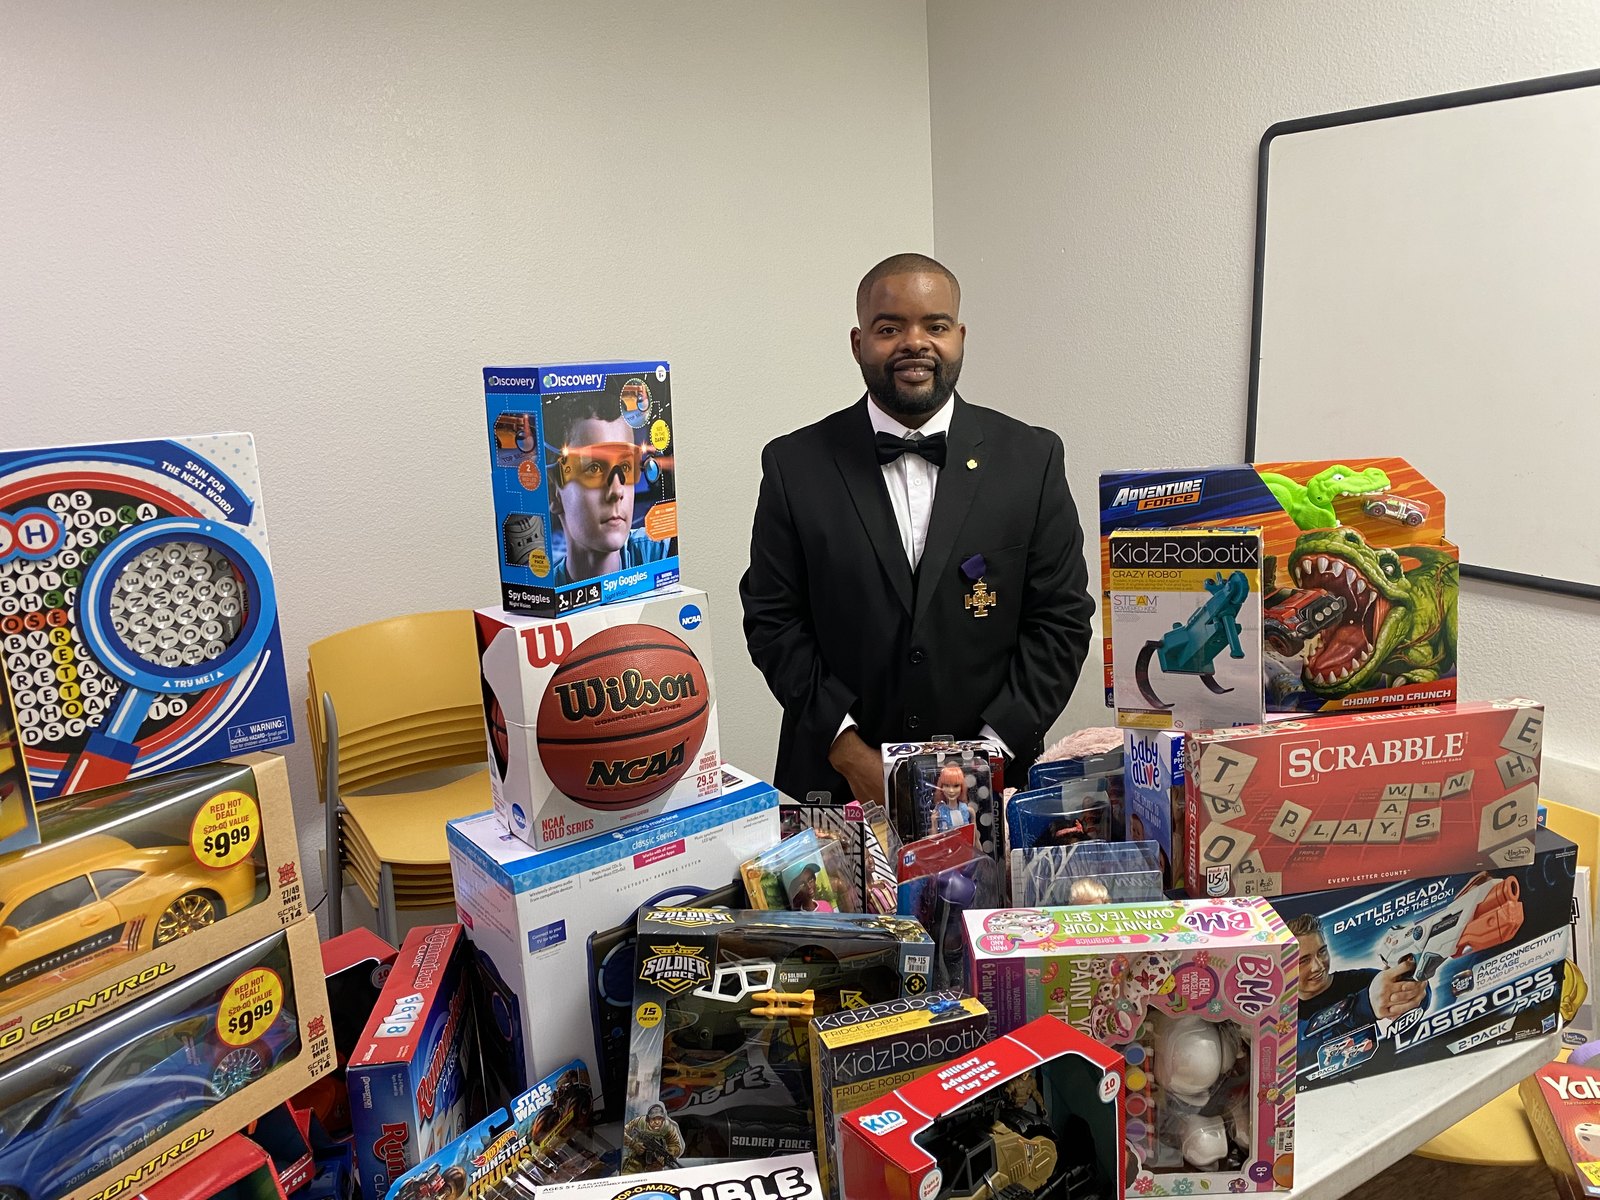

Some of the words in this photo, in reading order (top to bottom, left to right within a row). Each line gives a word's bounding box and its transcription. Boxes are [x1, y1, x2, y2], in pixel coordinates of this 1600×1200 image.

[491, 375, 536, 390] Discovery
[548, 373, 603, 389] Discovery
[185, 461, 209, 479] SPIN
[207, 476, 226, 493] FOR
[161, 461, 181, 476] THE
[180, 471, 206, 490] NEXT
[205, 487, 235, 514] WORD!
[1112, 478, 1203, 507] ADVENTURE
[1143, 494, 1194, 509] FORCE
[1112, 541, 1258, 564] KidzRobotix
[604, 580, 618, 591] Spy
[618, 571, 648, 588] Goggles
[1113, 570, 1145, 578] CRAZY
[1148, 570, 1183, 578] ROBOT
[508, 589, 521, 601] Spy
[522, 592, 550, 605] Goggles
[1113, 594, 1158, 606] STEAM
[681, 614, 701, 625] NCAA
[521, 622, 573, 668] W
[174, 680, 193, 688] TRY
[196, 674, 214, 685] ME!
[554, 668, 698, 722] Wilson
[1342, 697, 1379, 707] CHOMP
[1381, 694, 1404, 703] AND
[1407, 689, 1451, 701] CRUNCH
[594, 710, 647, 727] COMPOSITE
[649, 703, 681, 714] LEATHER
[250, 720, 284, 733] WARNING:
[1131, 734, 1158, 766] baby
[1288, 732, 1465, 778] SCRABBLE
[586, 741, 687, 787] NCAA
[699, 761, 717, 772] OUTDOOR
[697, 771, 718, 788] 29.5"
[1132, 760, 1159, 788] alive
[210, 802, 225, 814] RED
[227, 798, 242, 809] HOT
[215, 808, 237, 820] DEAL!
[846, 809, 861, 818] 126
[228, 815, 249, 827] VALUE
[541, 817, 564, 831] NCAA
[543, 828, 564, 842] GOLD
[567, 819, 594, 835] SERIES
[632, 835, 656, 850] classic
[656, 829, 678, 842] series
[1188, 801, 1198, 887] SCRABBLE
[903, 855, 915, 865] DC
[1208, 872, 1229, 886] USA
[1352, 873, 1378, 881] LETTER
[1380, 869, 1407, 878] COUNTS
[282, 885, 299, 900] 27/49
[1245, 885, 1255, 894] 8+
[277, 902, 302, 917] SCALE
[1098, 909, 1131, 921] TEA
[1133, 908, 1175, 919] OWN
[1333, 901, 1392, 935] BATTLE
[1395, 878, 1449, 908] READY
[1375, 914, 1395, 927] OUT
[1396, 907, 1411, 917] OF
[1411, 898, 1429, 911] THE
[1430, 888, 1455, 903] BOX!
[280, 909, 302, 925] 1:14
[1063, 911, 1093, 923] SET
[1115, 919, 1164, 933] PAINT
[1063, 921, 1113, 935] YOUR
[1074, 937, 1115, 945] ceramics
[1477, 960, 1499, 973] APP
[1499, 931, 1563, 963] CONNECTIVITY
[377, 970, 390, 979] 10
[644, 956, 706, 978] SOLDIER
[656, 970, 695, 980] FORCE
[1477, 979, 1487, 987] TO
[1487, 972, 1503, 982] AMP
[1503, 967, 1515, 976] UP
[1515, 957, 1535, 969] YOUR
[1535, 948, 1555, 962] PLAY!
[1477, 957, 1520, 981] PACKAGE
[235, 983, 249, 996] RED
[251, 975, 265, 986] HOT
[911, 978, 924, 991] 3+
[982, 971, 996, 990] Paint
[1069, 959, 1092, 1009] PAINT
[1182, 973, 1190, 984] TEA
[1190, 972, 1198, 1000] PORCELAIN
[1199, 978, 1210, 996] REAL
[30, 962, 176, 1035] CONTROL
[239, 986, 260, 1001] DEAL!
[252, 989, 272, 1004] VALUE
[1513, 985, 1556, 1014] PRO
[643, 1007, 657, 1016] 15
[814, 988, 964, 1031] KidzRobotix
[1394, 996, 1488, 1051] LASER
[1492, 966, 1554, 1007] OPS
[387, 1026, 407, 1034] 8
[824, 1022, 865, 1039] FRIDGE
[866, 1016, 904, 1029] ROBOT
[1386, 1009, 1421, 1040] NERF
[311, 1037, 328, 1053] 27/49
[1458, 1021, 1509, 1051] 2-PACK
[833, 1024, 989, 1081] KidzRobotix
[307, 1053, 331, 1071] SCALE
[310, 1062, 331, 1078] 1:14
[937, 1057, 980, 1080] Military
[941, 1060, 996, 1090] Adventure
[955, 1079, 982, 1094] Play
[980, 1069, 1000, 1081] Set
[1311, 1065, 1336, 1080] 2-PACK
[836, 1083, 875, 1098] FRIDGE
[878, 1072, 917, 1089] ROBOT
[1104, 1077, 1116, 1092] 10
[514, 1082, 552, 1113] STAR
[514, 1089, 554, 1122] WARS
[862, 1111, 901, 1132] KID
[732, 1136, 774, 1147] SOLDIER
[779, 1138, 811, 1149] FORCE
[65, 1171, 87, 1188] 2015
[112, 1129, 155, 1160] MUSTANG
[156, 1121, 168, 1132] GT
[470, 1135, 528, 1183] MONSTER
[485, 1143, 498, 1162] HOT
[291, 1171, 307, 1187] Set
[469, 1145, 535, 1200] TRUCKS
[923, 1181, 940, 1198] Sound
